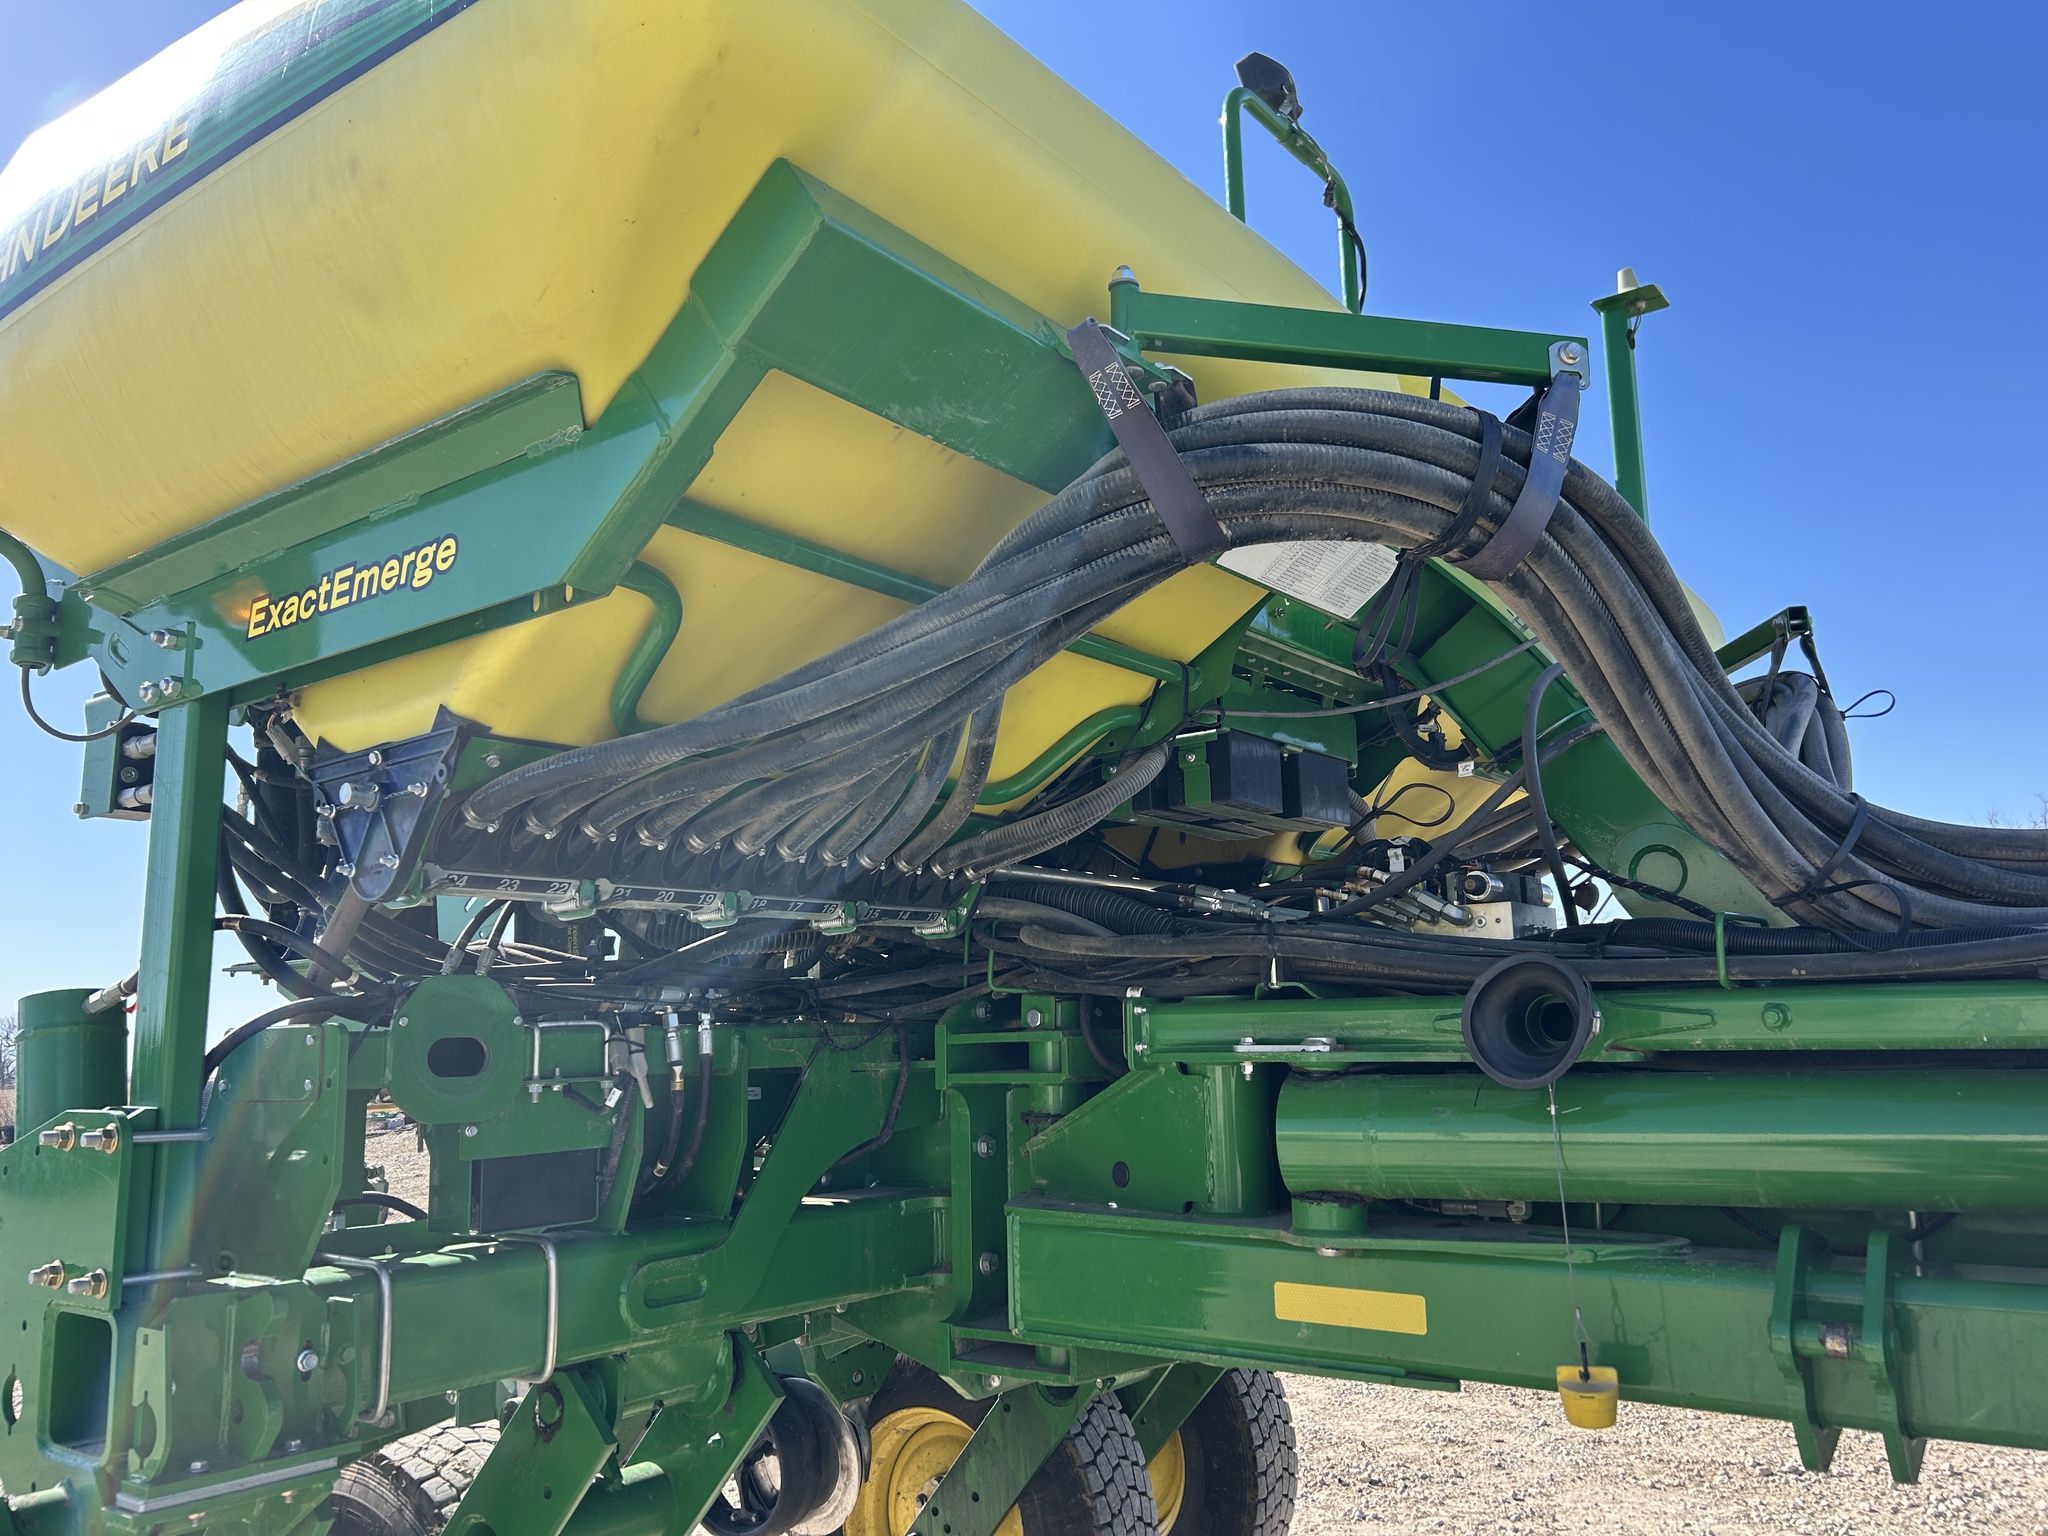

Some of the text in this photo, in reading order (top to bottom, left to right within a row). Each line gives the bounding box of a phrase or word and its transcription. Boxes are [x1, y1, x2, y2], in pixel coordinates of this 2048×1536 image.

[42, 107, 190, 251] DEERE
[246, 536, 458, 640] ExactEmerge
[496, 878, 521, 891] 23
[545, 883, 570, 895] 22
[614, 887, 715, 905] 21 20 19
[787, 902, 803, 912] 17
[821, 904, 837, 914] 16
[866, 908, 941, 922] 15 14 13
